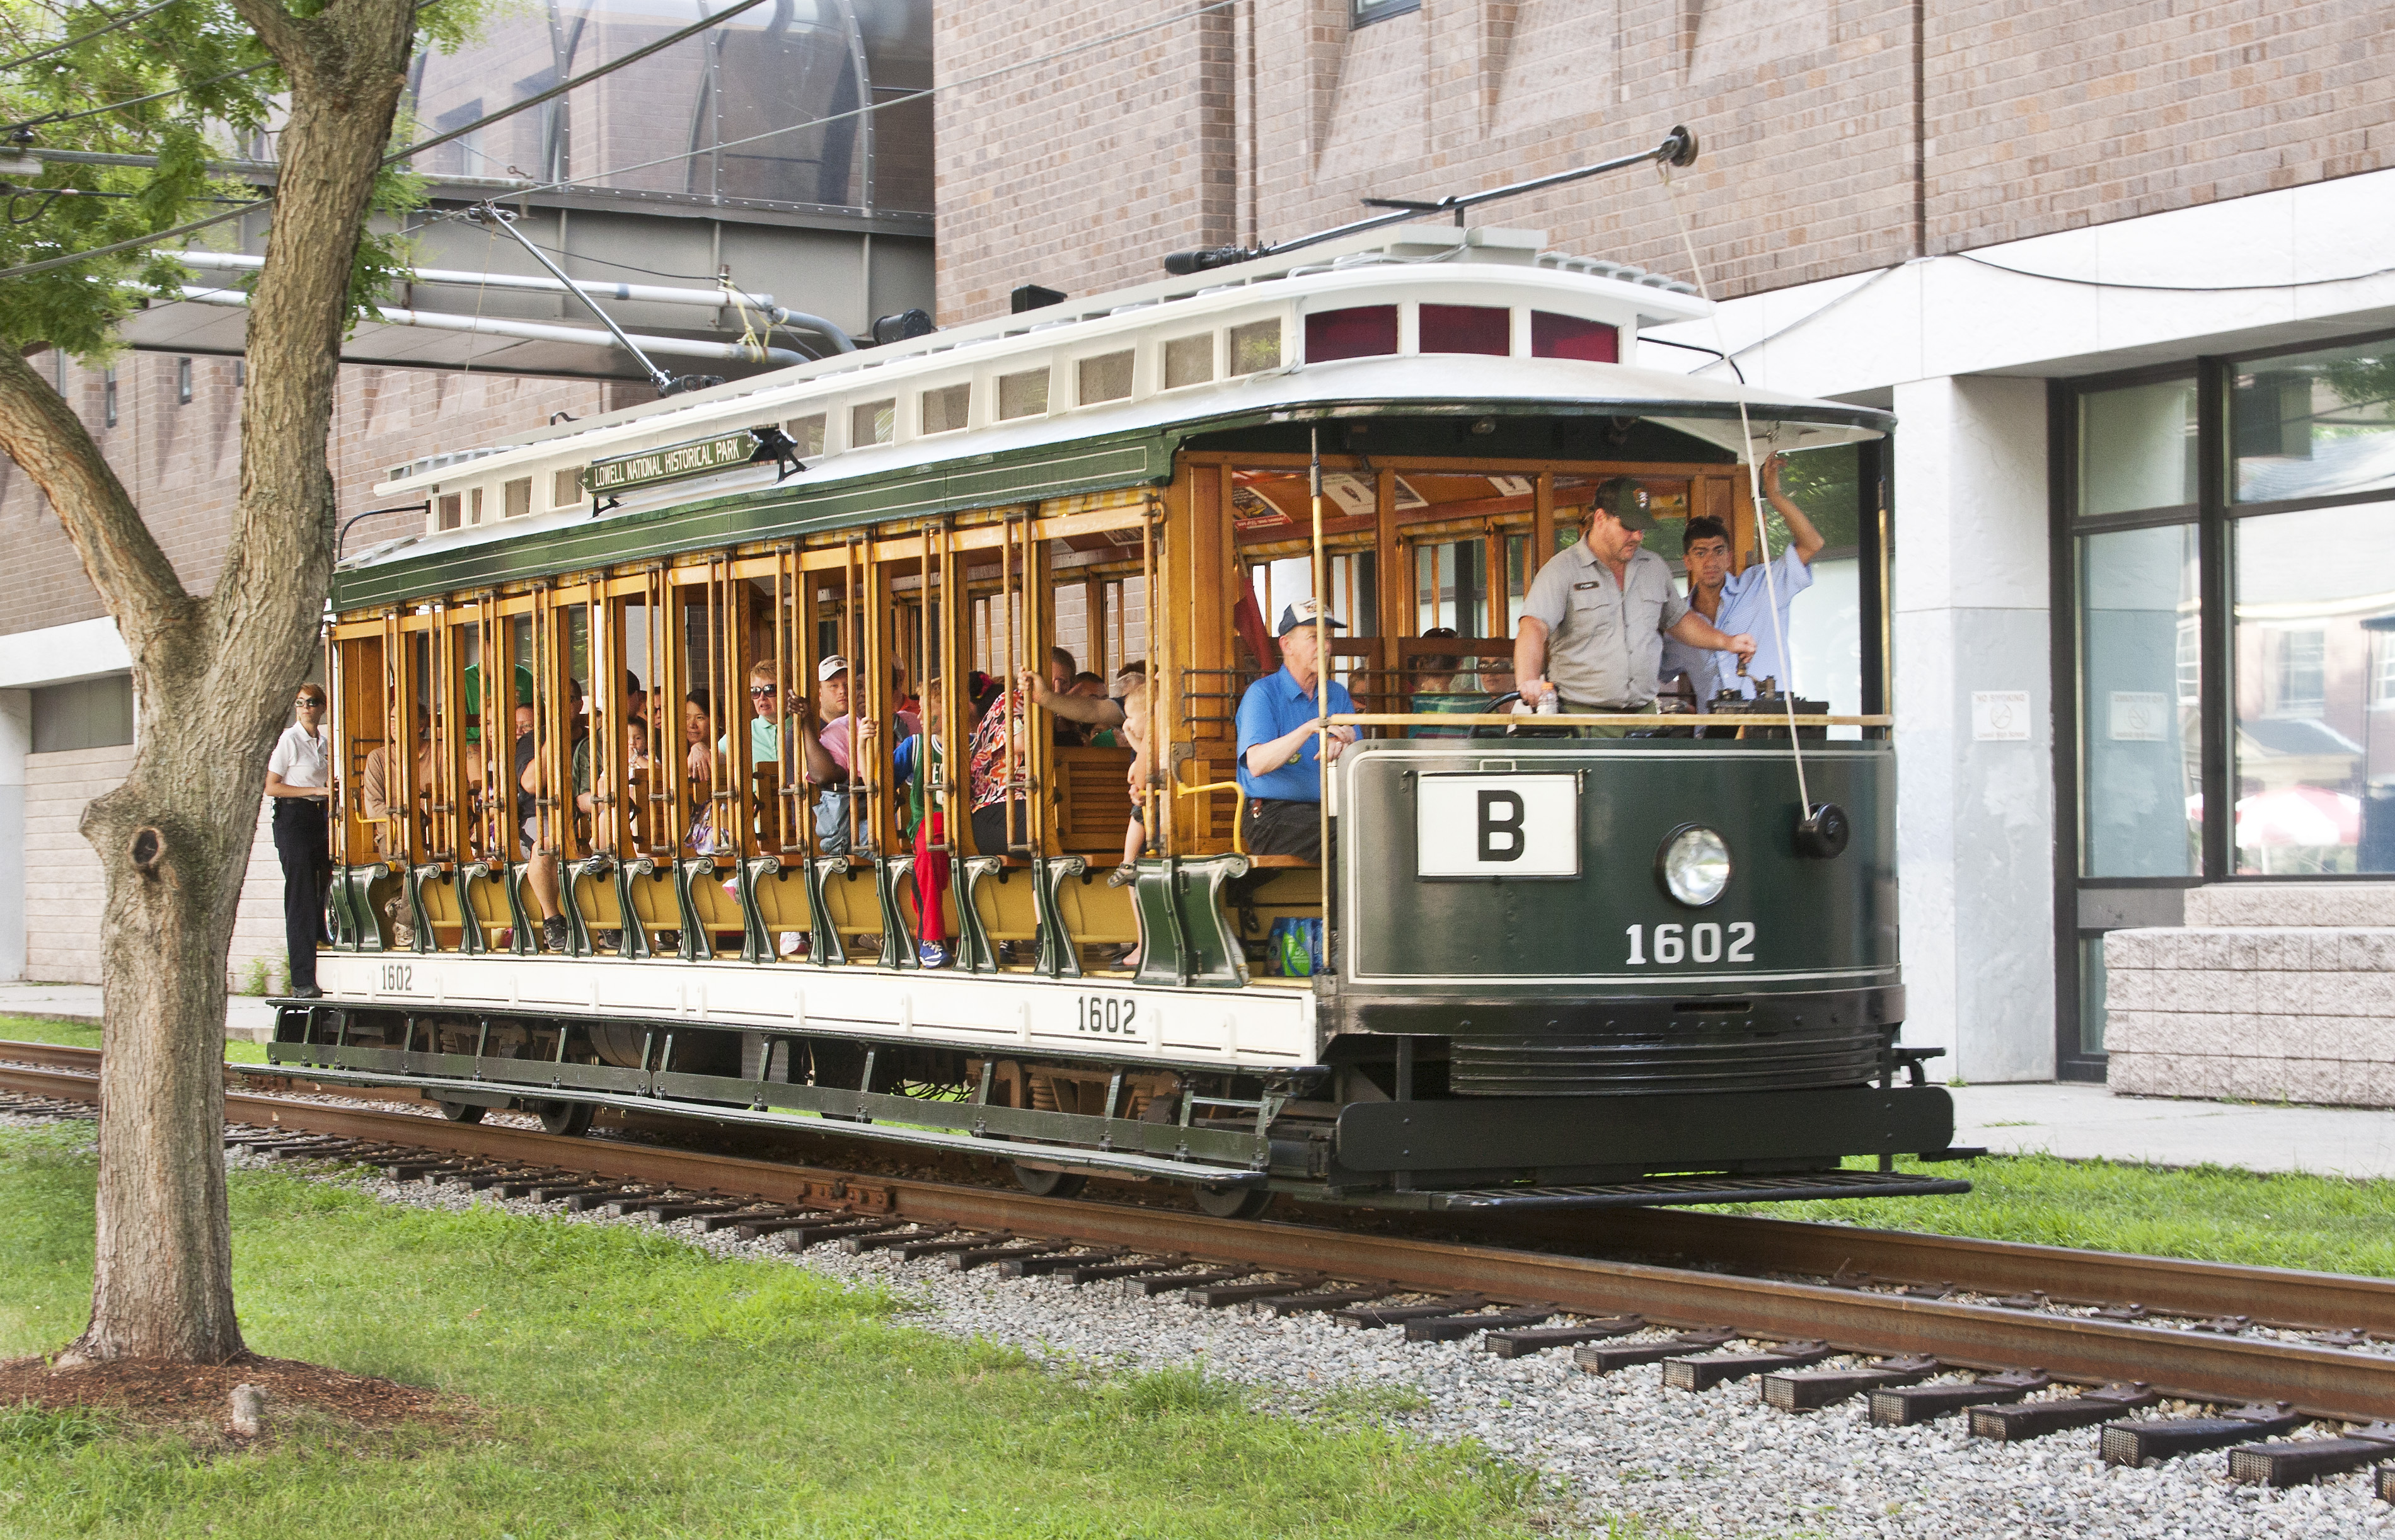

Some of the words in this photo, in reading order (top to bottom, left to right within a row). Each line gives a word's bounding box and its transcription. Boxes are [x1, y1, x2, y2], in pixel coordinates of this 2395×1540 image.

[595, 463, 625, 487] LOWELL
[626, 455, 663, 481] NATIONAL
[665, 444, 713, 474] HISTORICAL
[715, 438, 739, 463] PARK
[1976, 694, 1988, 703] NO
[1477, 790, 1525, 861] B
[1625, 921, 1756, 965] 1602
[382, 964, 412, 991] 1602
[1078, 996, 1136, 1035] 1602
